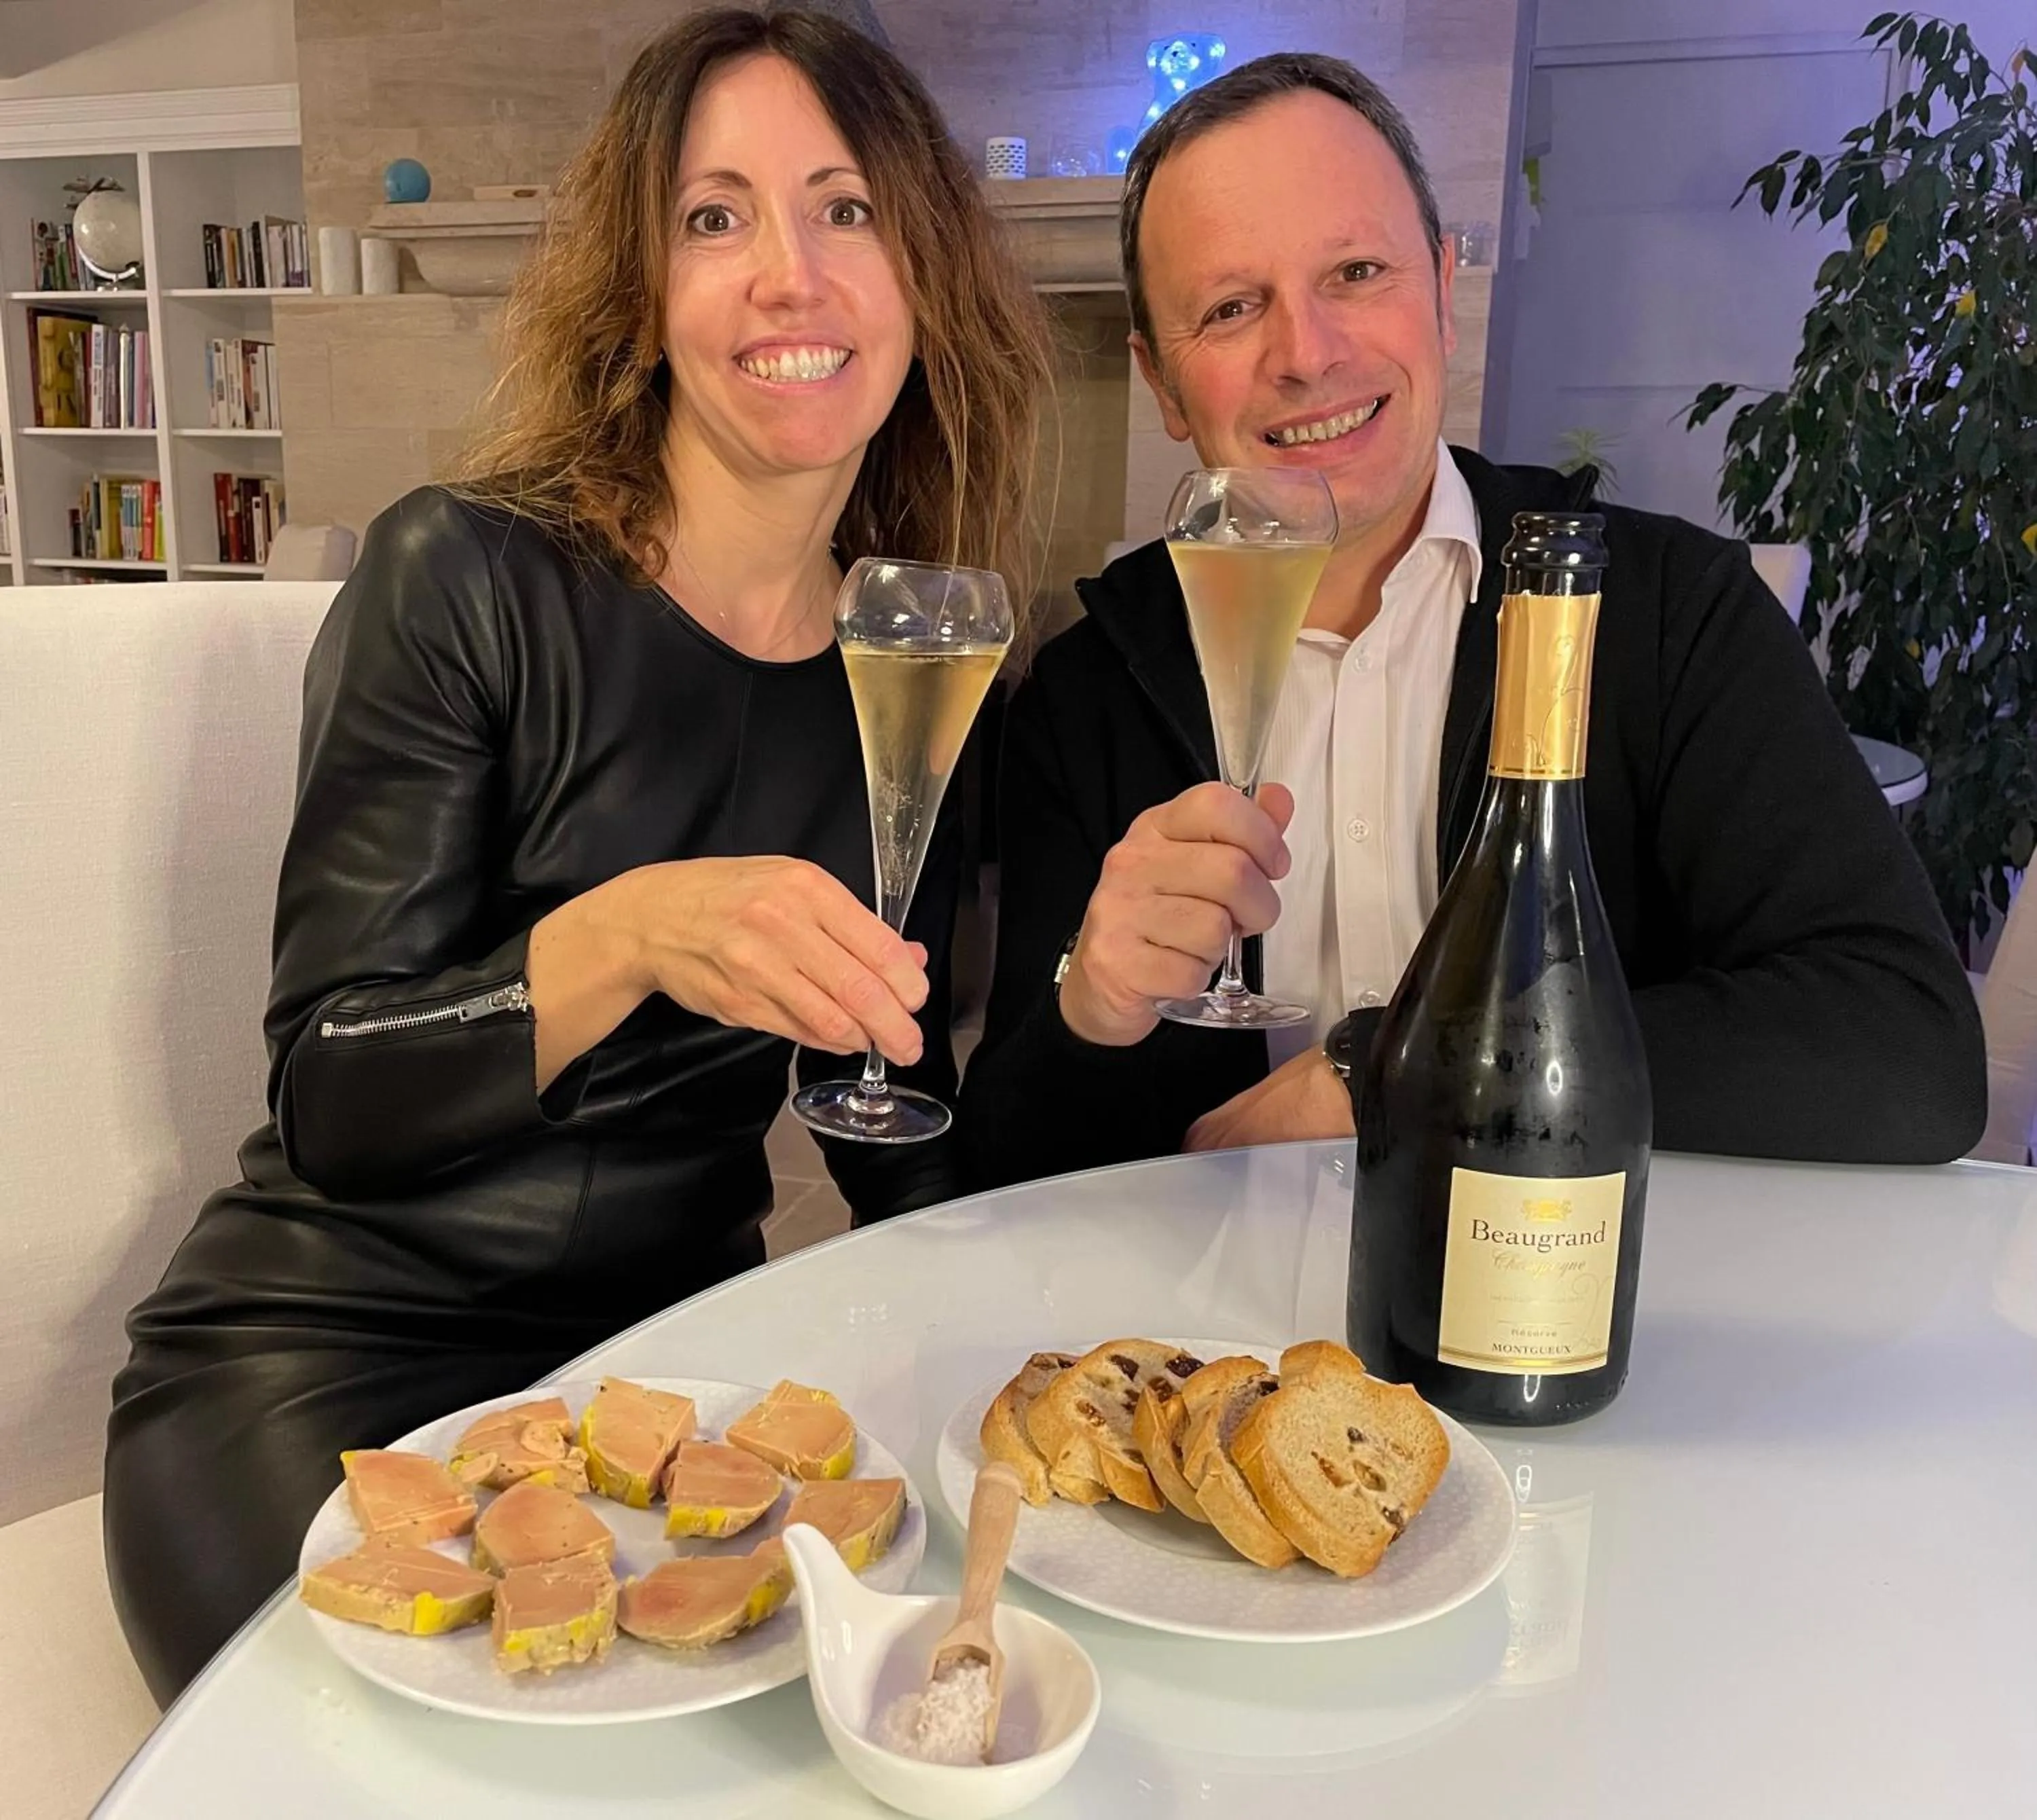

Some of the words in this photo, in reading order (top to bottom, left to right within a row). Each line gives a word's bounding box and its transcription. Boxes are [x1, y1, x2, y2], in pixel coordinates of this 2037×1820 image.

[1471, 1219, 1606, 1253] Beaugrand
[1491, 1249, 1586, 1280] Chpgne
[1492, 1343, 1571, 1354] MONTGUEUX
